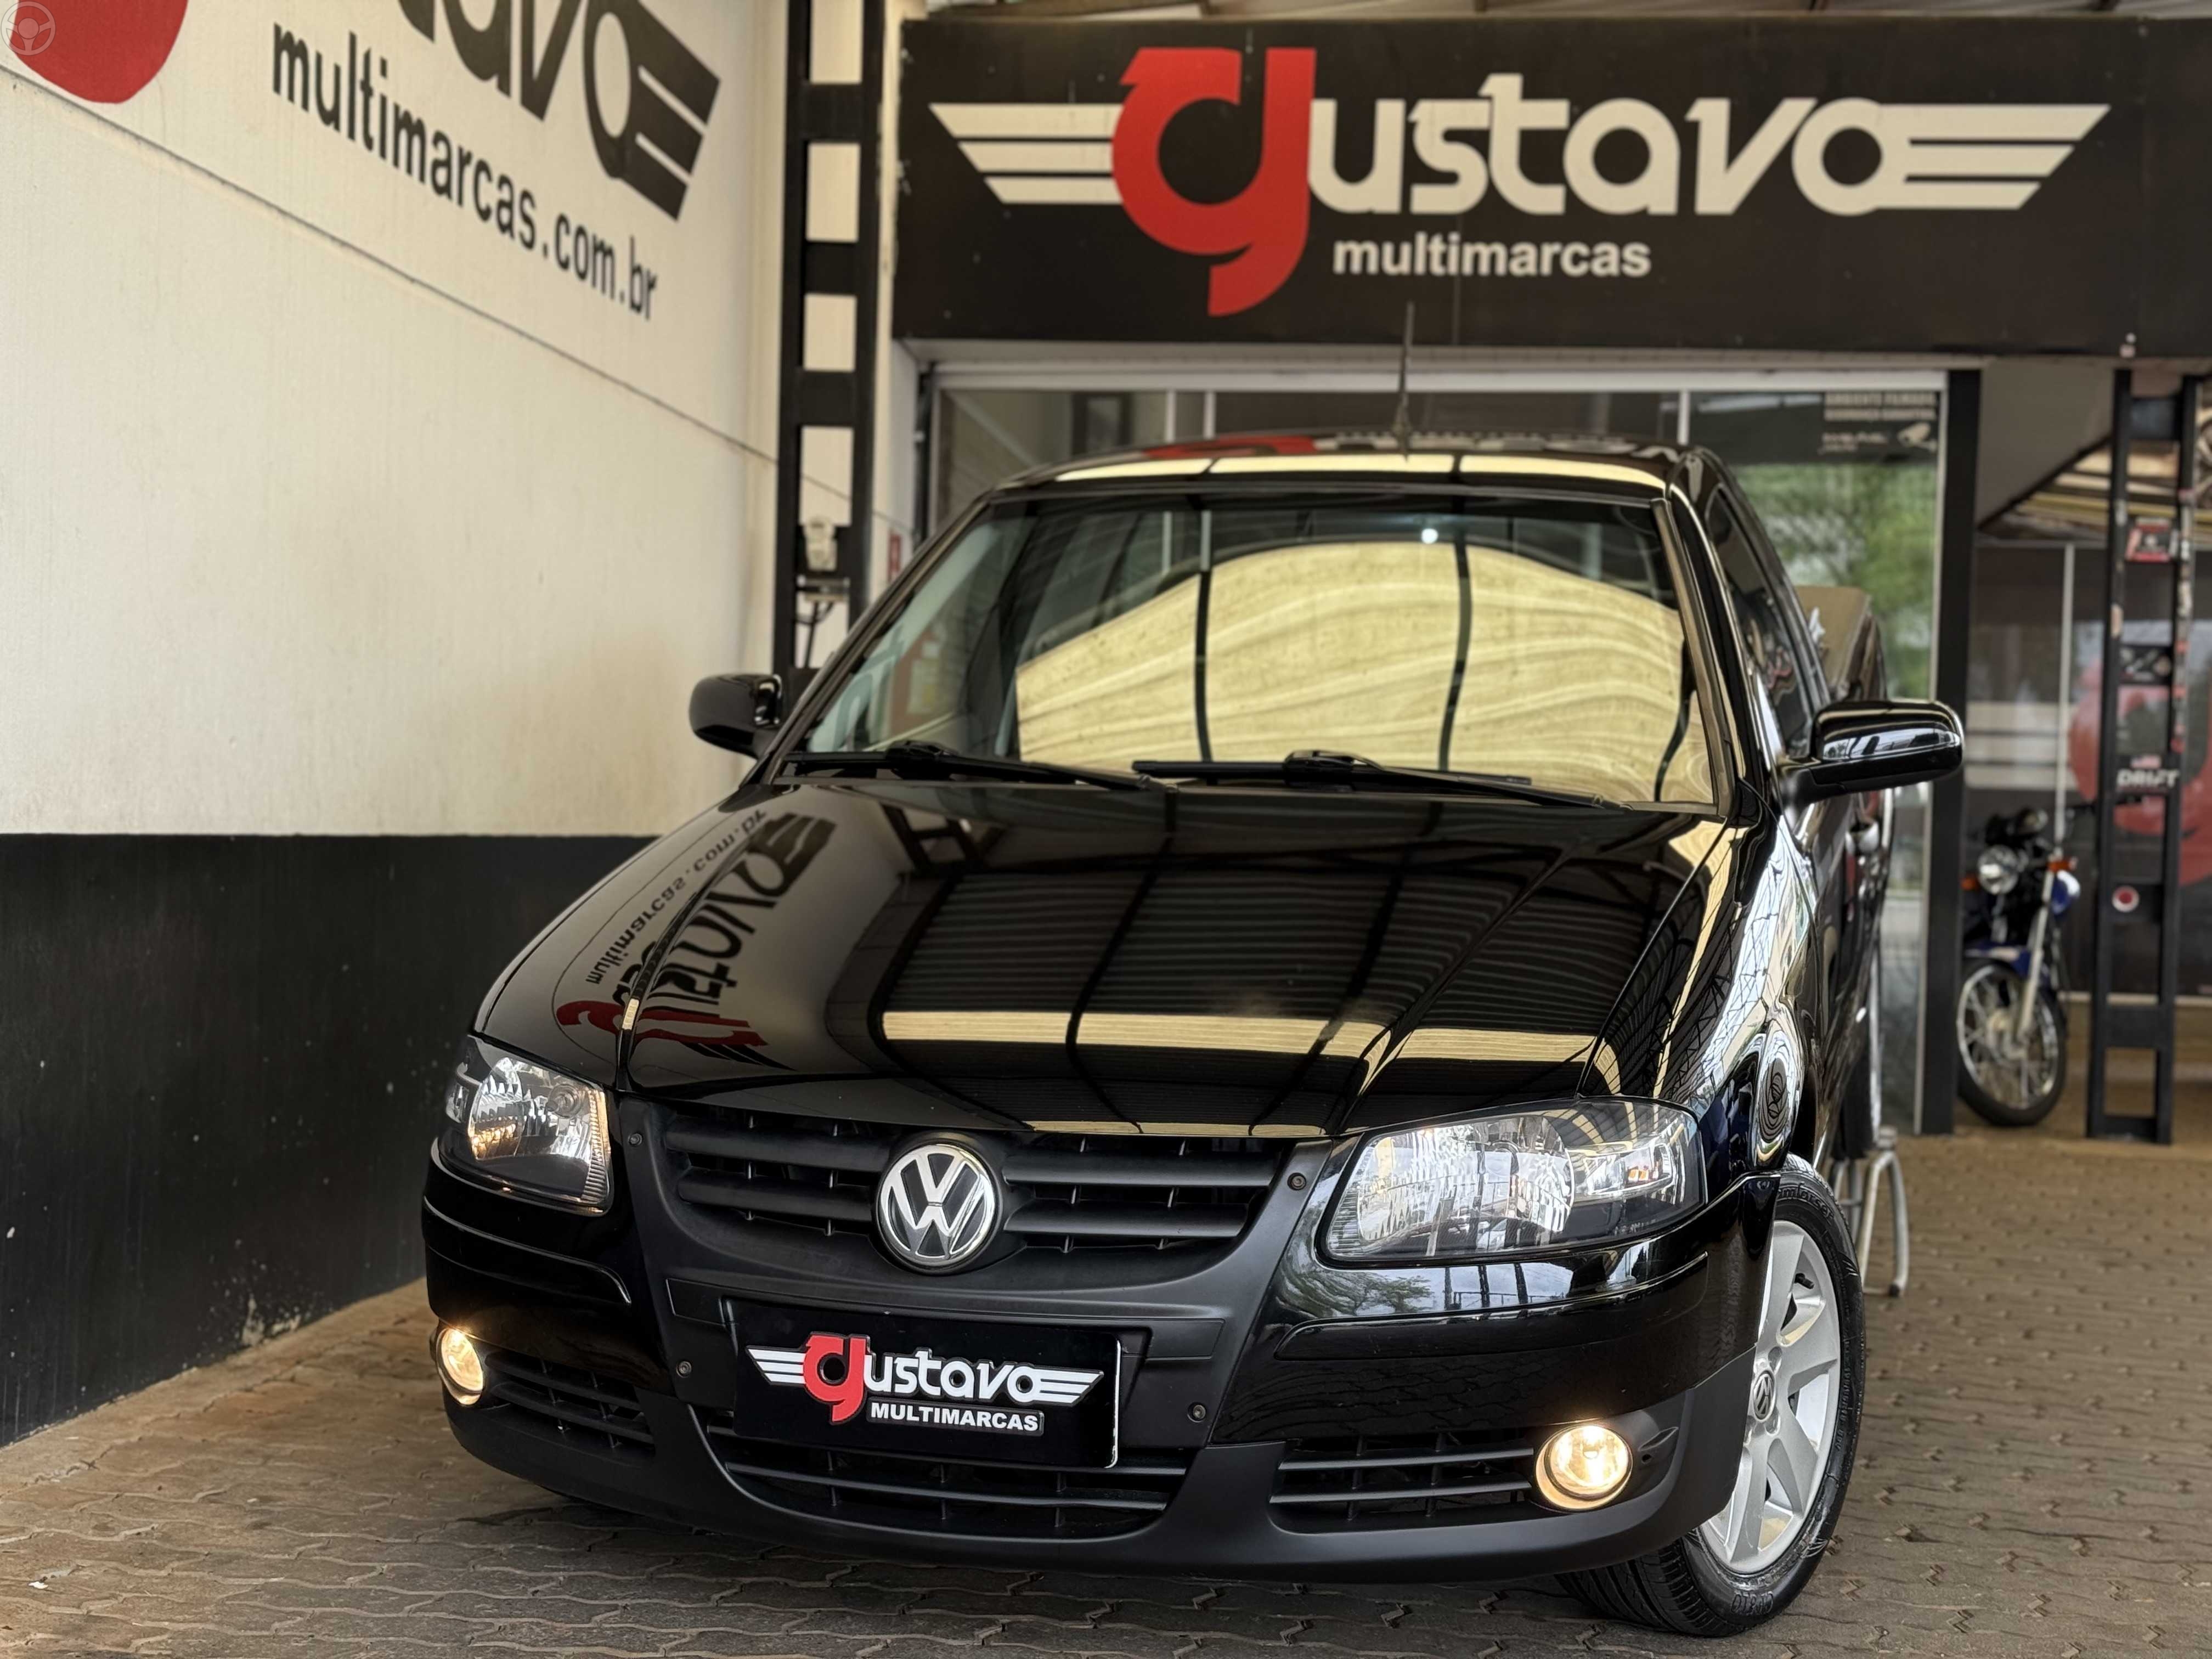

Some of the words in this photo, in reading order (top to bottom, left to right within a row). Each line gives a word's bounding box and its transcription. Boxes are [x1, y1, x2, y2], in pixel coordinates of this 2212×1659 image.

[274, 22, 658, 321] multimarcas.com.br
[1111, 47, 1906, 317] gustavo
[1333, 232, 1651, 277] multimarcas
[878, 1143, 997, 1266] VW
[1778, 1183, 1835, 1225] mforser
[803, 1334, 1043, 1423] gustavo
[870, 1402, 1040, 1432] MULTIMARCAS
